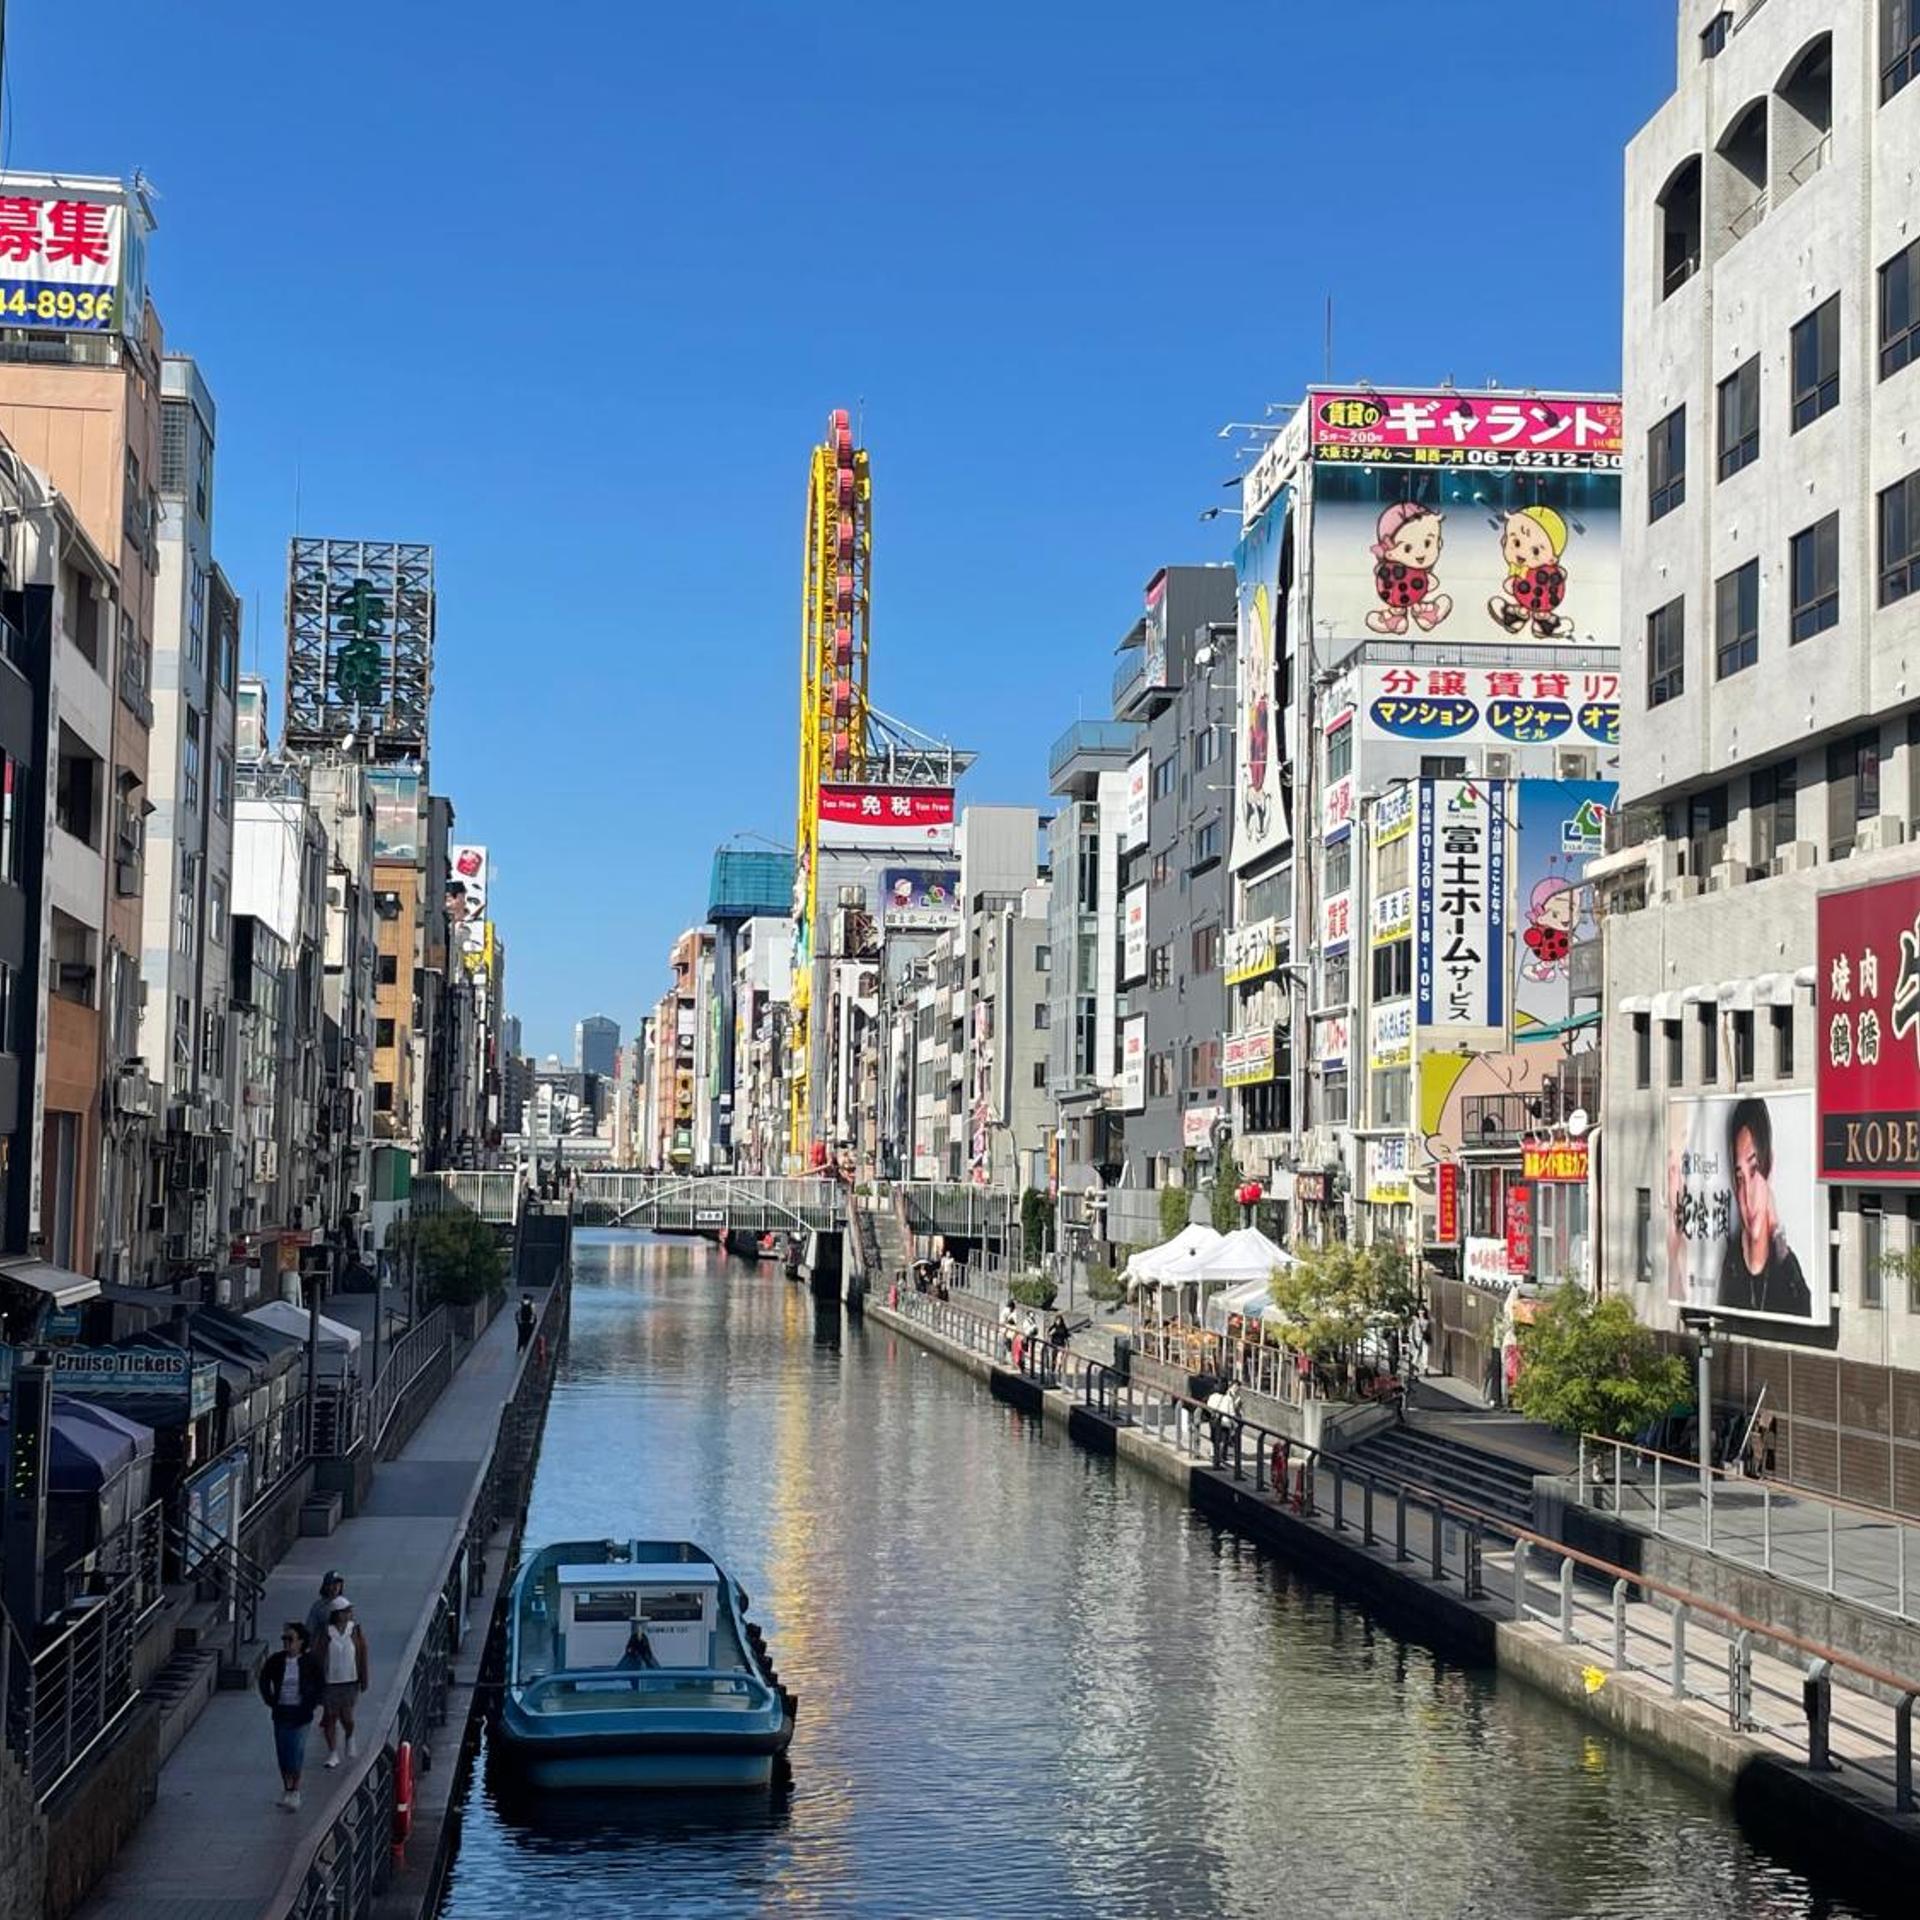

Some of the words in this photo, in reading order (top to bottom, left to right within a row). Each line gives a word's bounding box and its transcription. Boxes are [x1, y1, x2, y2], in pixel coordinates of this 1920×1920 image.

[0, 197, 110, 266] 募集
[0, 288, 113, 321] 4-8936
[1385, 400, 1608, 446] ギャラント
[1381, 669, 1467, 697] 分譲
[1485, 671, 1570, 699] 賃貸
[1378, 701, 1474, 727] マンション
[1493, 704, 1571, 727] レジャー
[861, 795, 911, 816] 免税
[1440, 824, 1482, 1021] 富士ホームサービス
[1831, 947, 1878, 1002] 焼肉
[1830, 1008, 1881, 1068] 鶴橋
[1846, 1119, 1920, 1164] KOBE
[55, 1352, 115, 1372] Cruise
[118, 1354, 183, 1373] Tickets
